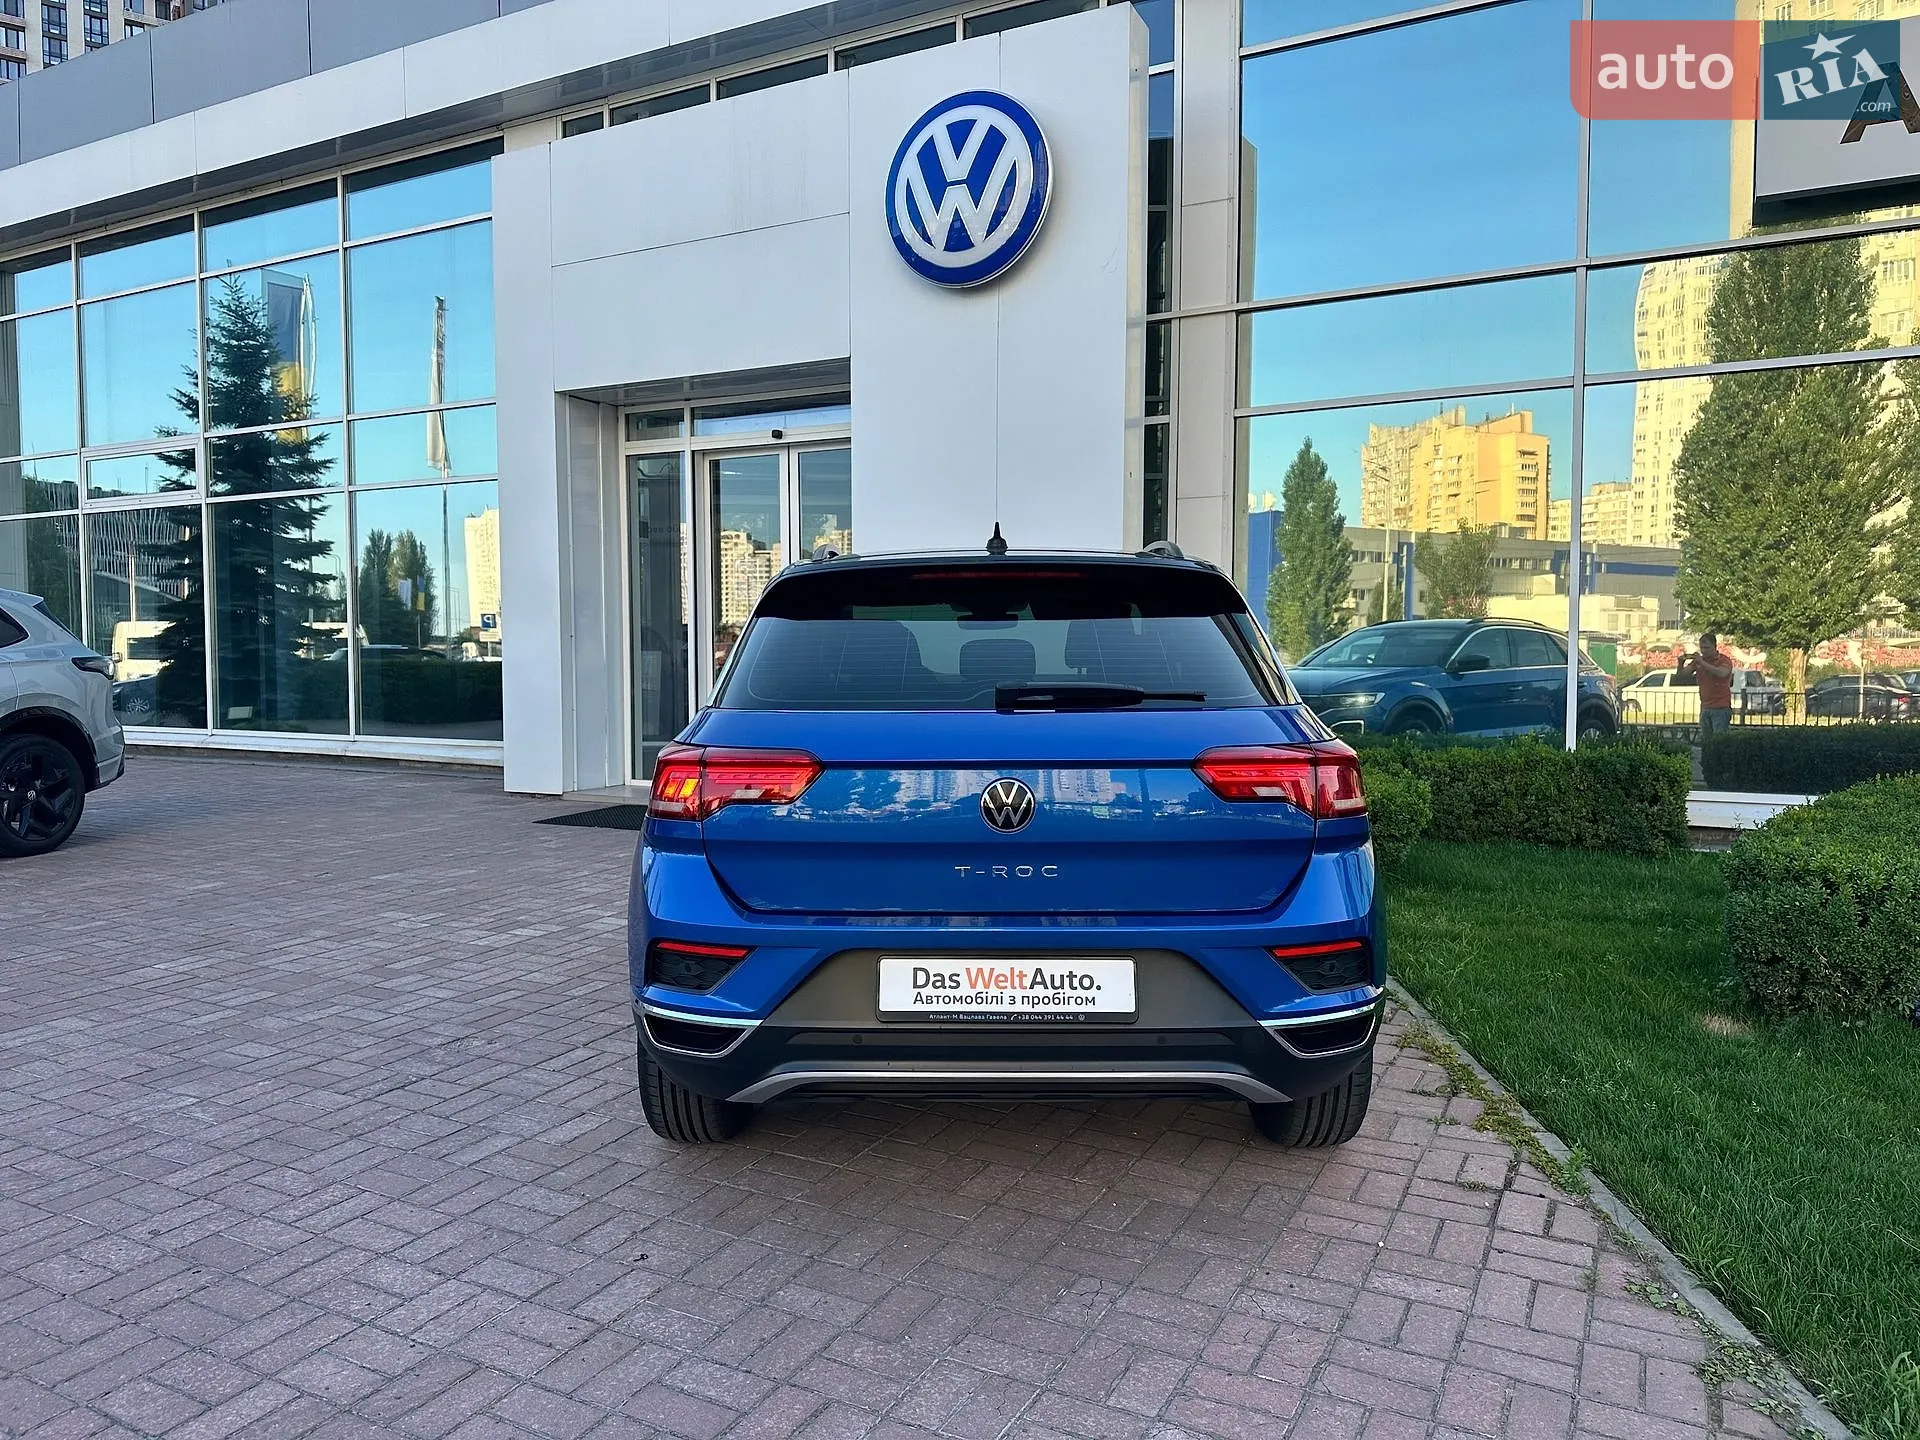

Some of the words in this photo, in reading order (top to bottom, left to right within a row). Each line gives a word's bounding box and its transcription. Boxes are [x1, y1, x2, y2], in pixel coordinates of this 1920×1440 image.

[954, 865, 1058, 878] T-ROC
[912, 966, 961, 990] Das
[965, 966, 1102, 991] WeltAuto.
[913, 991, 1004, 1005] Автомобілі
[1008, 995, 1017, 1005] з
[1021, 991, 1096, 1009] пробігом
